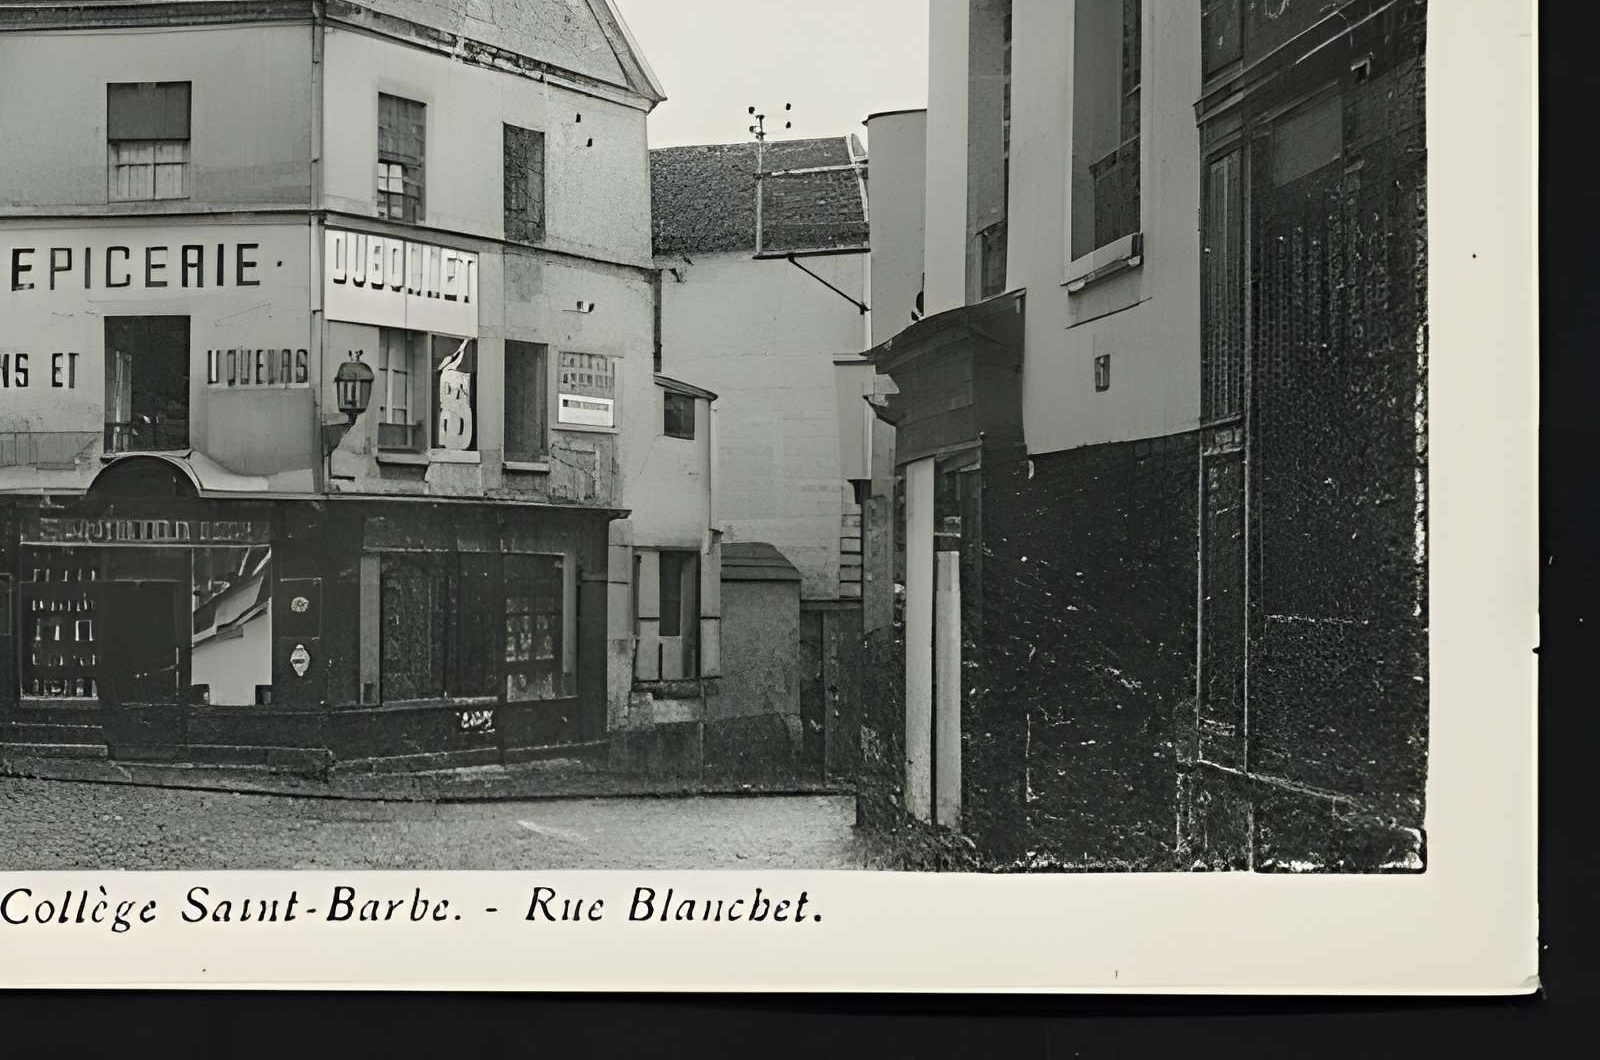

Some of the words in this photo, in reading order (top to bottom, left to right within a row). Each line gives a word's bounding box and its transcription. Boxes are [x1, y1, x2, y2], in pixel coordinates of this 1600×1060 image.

[11, 243, 261, 292] EPICERIE
[331, 234, 478, 304] DUBONNET
[51, 352, 80, 389] ET
